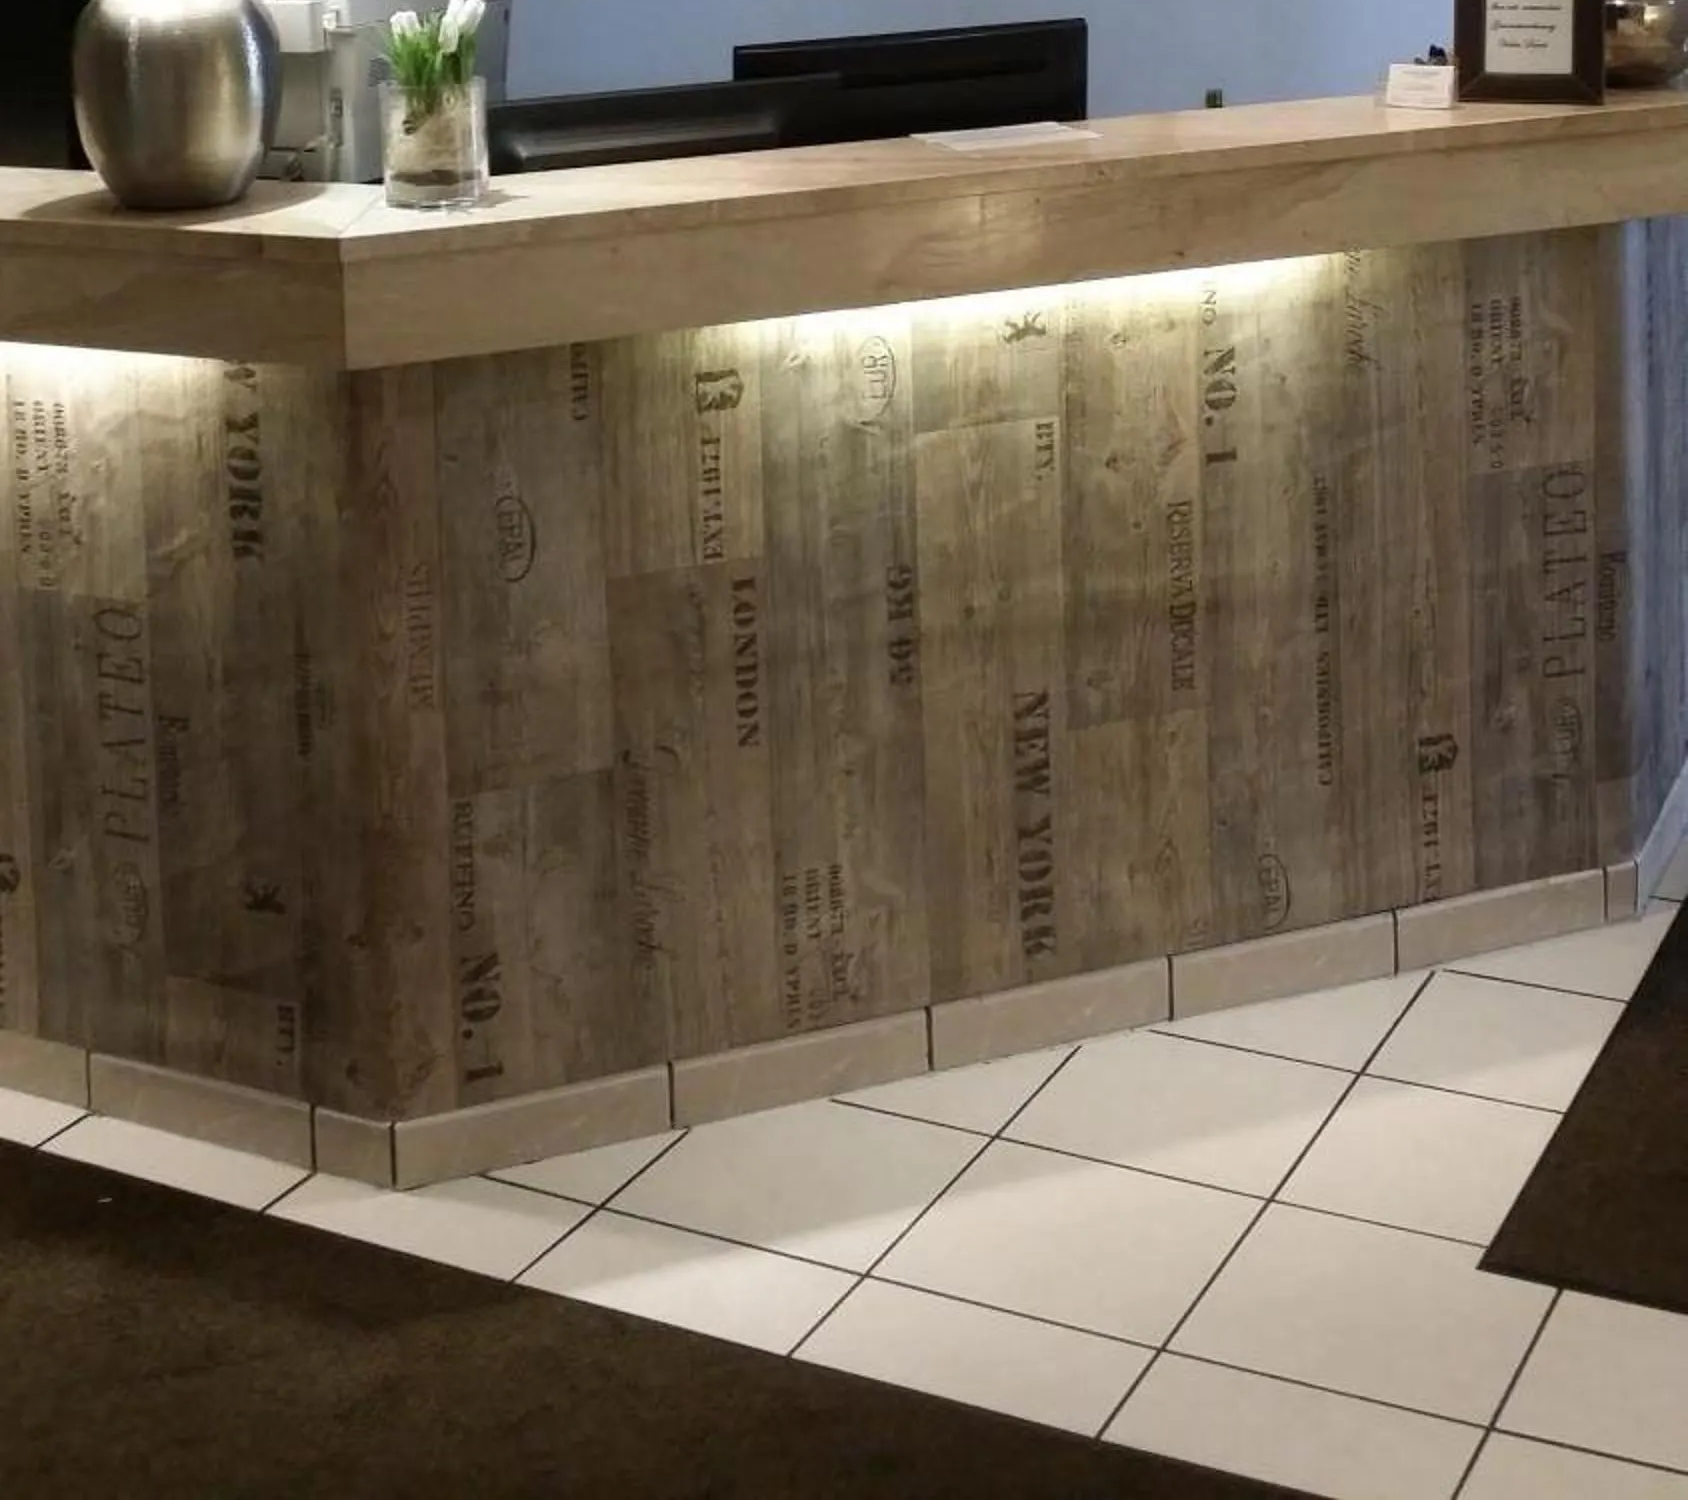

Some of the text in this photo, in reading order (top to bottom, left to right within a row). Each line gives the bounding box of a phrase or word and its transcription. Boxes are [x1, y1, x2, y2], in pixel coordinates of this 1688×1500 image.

[225, 411, 264, 566] YORK
[1540, 467, 1588, 680] PLATEO
[93, 607, 150, 843] PLATEO
[731, 576, 761, 748] LONDON
[1012, 687, 1057, 957] NEW YORK
